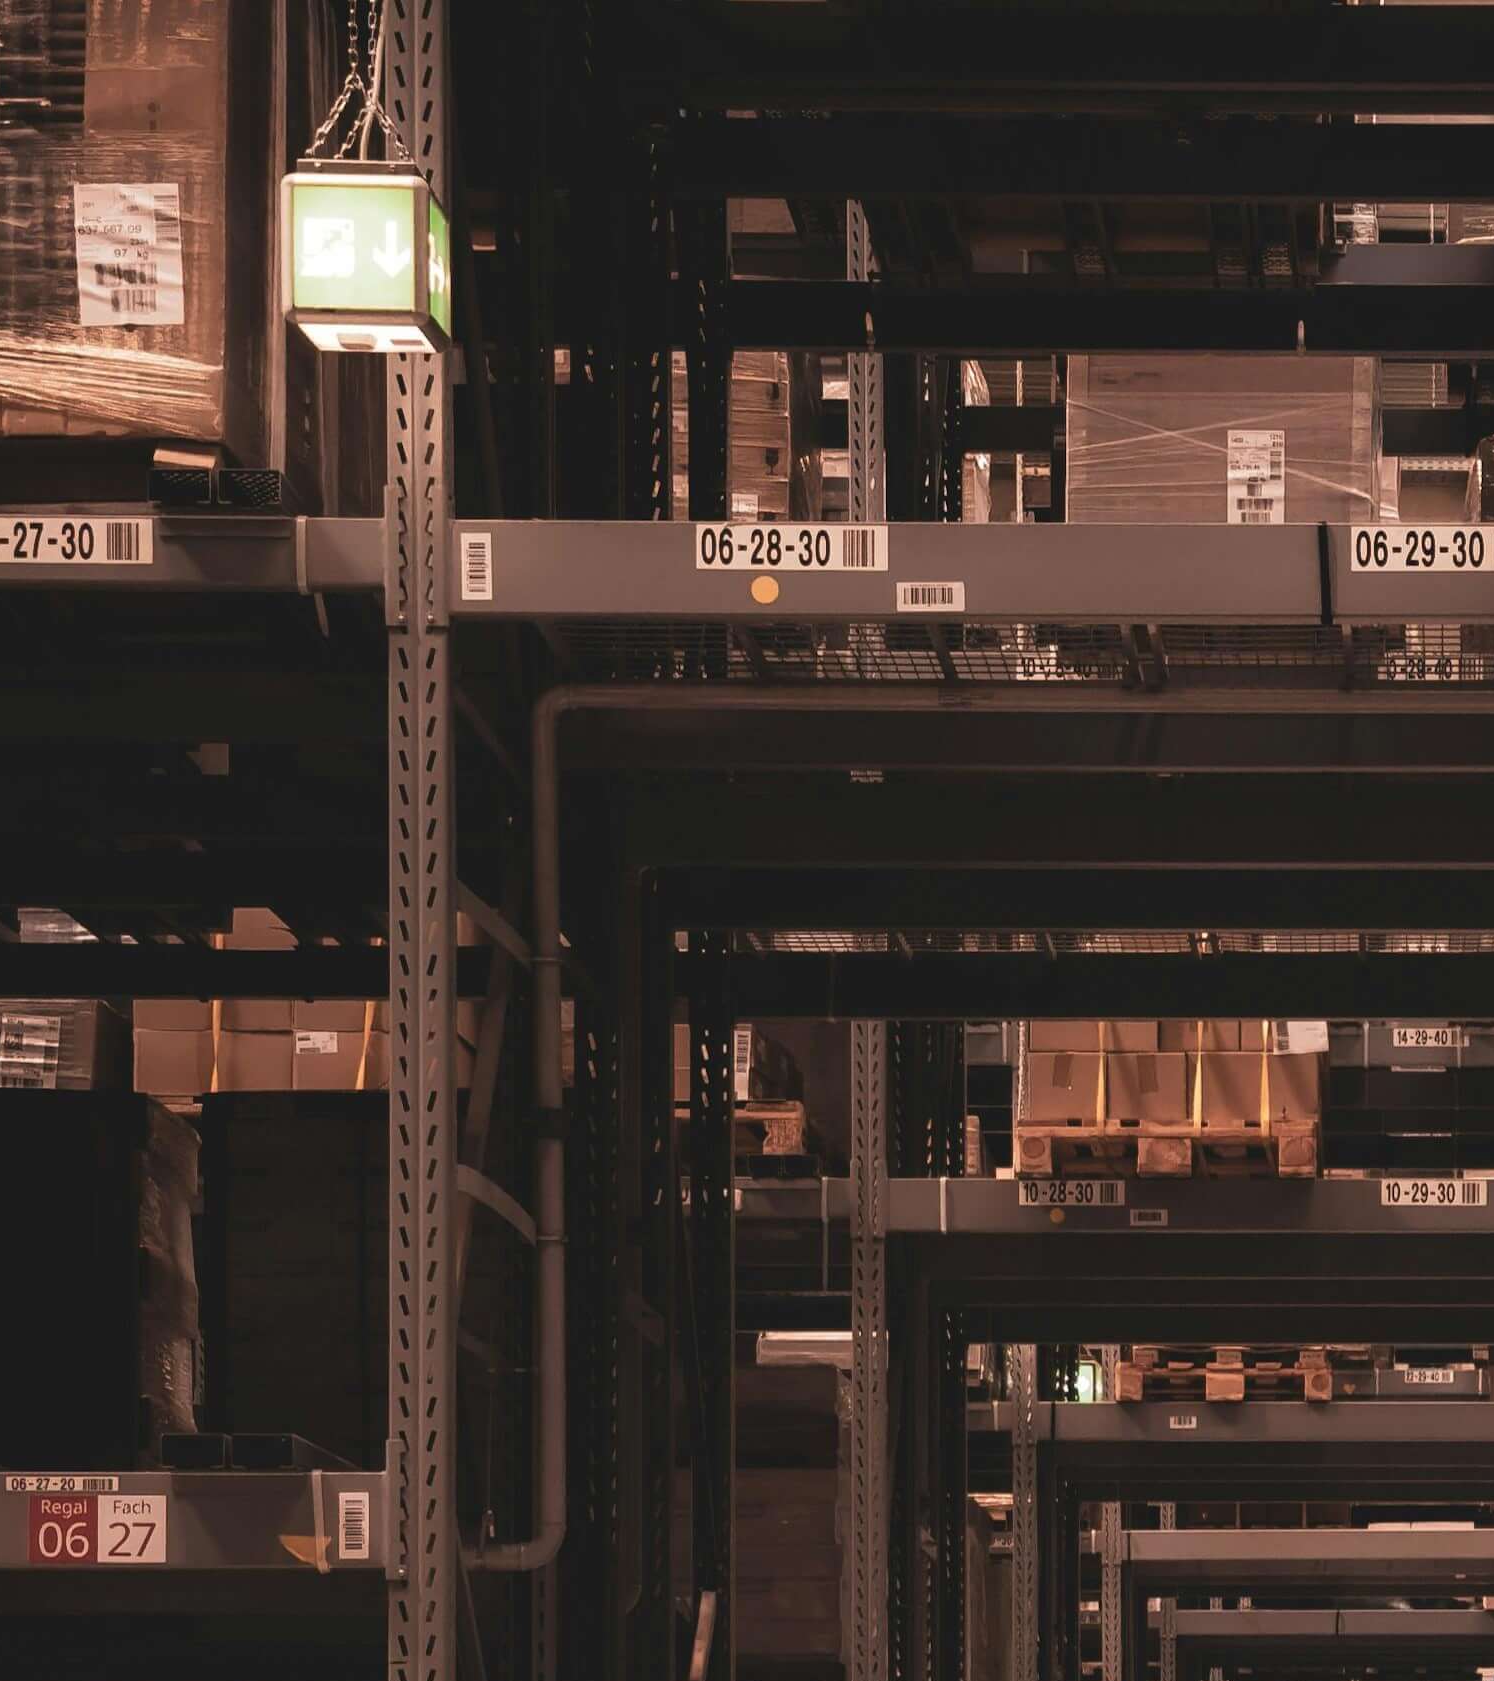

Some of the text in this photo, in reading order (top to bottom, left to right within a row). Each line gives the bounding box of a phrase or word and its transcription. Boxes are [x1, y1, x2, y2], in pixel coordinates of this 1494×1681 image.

[701, 528, 831, 566] 06-28-30
[1356, 530, 1485, 567] 06-29-30
[1397, 1030, 1448, 1045] 14-29-40
[1024, 1182, 1093, 1203] 10-28-30
[1386, 1182, 1455, 1203] 10-29-30
[11, 1478, 75, 1490] 06-27-20
[41, 1500, 88, 1519] Regal
[113, 1501, 151, 1514] Fach
[38, 1522, 89, 1558] 06
[108, 1522, 156, 1557] 27
